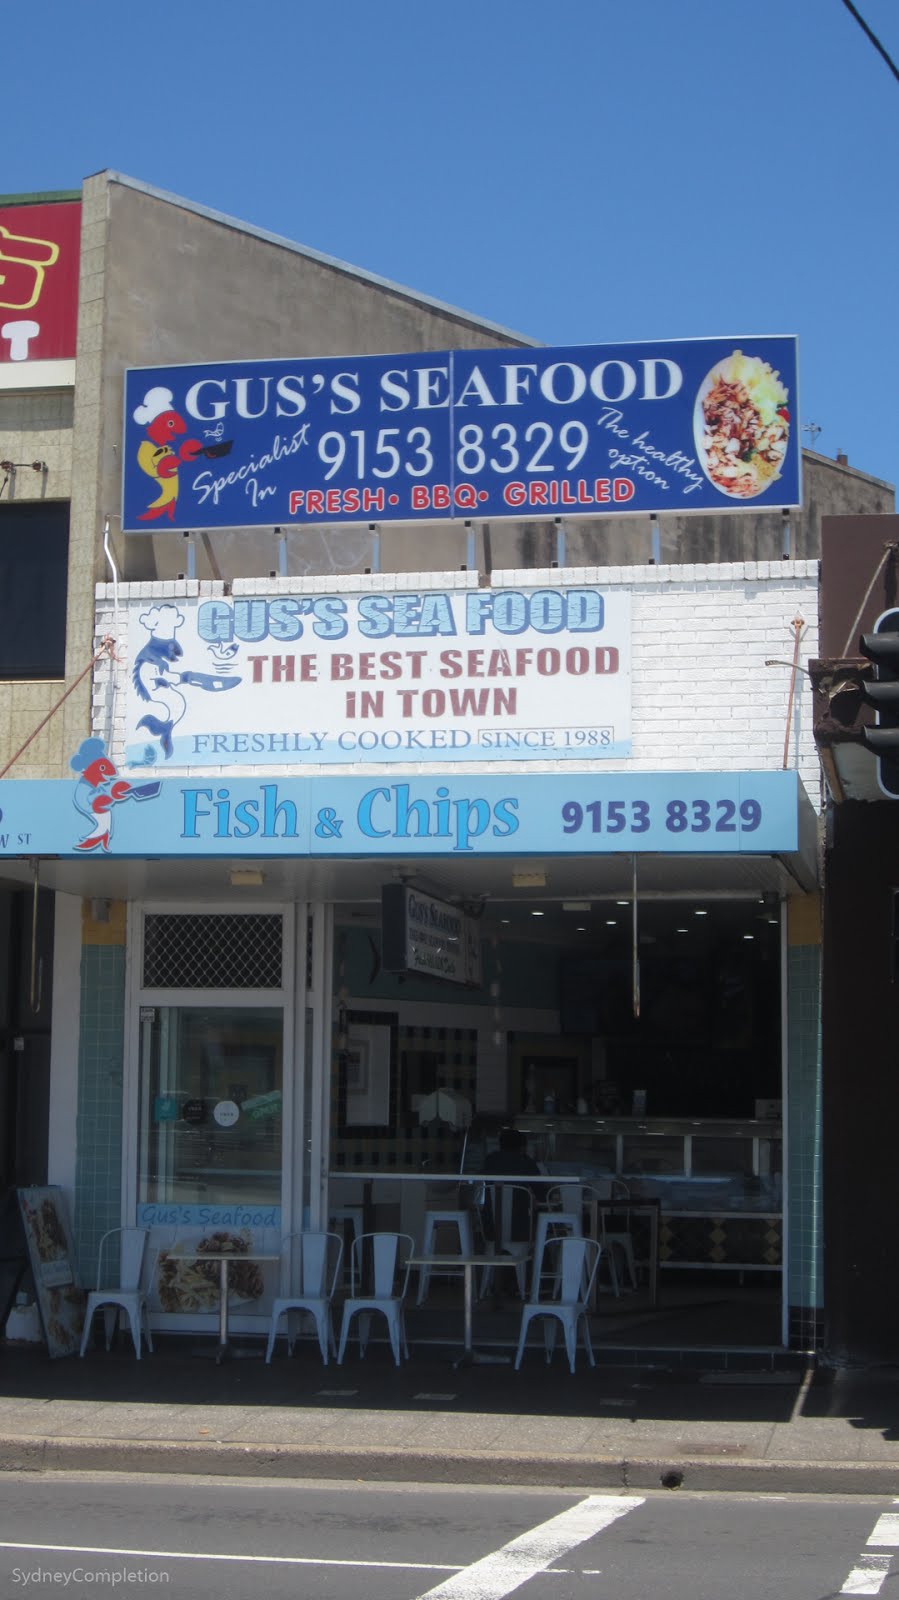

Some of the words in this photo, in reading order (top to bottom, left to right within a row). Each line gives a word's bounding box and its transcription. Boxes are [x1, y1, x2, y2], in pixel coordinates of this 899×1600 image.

[185, 372, 361, 421] GUS'S
[380, 358, 683, 412] SEAFOOD
[192, 423, 311, 505] Specialist
[318, 426, 433, 481] 9153
[456, 420, 588, 475] 8329
[597, 406, 630, 438] The
[631, 431, 704, 494] healthy
[608, 448, 670, 490] option
[245, 478, 277, 507] In
[503, 478, 635, 507] GRILLED
[198, 596, 348, 643] GUS'S
[358, 592, 457, 639] SEA
[466, 589, 605, 635] FOOD
[248, 653, 318, 683] THE
[330, 651, 428, 681] BEST
[439, 646, 619, 679] SEAFOOD
[396, 687, 517, 718] TOWN
[192, 731, 329, 754] FRESHLY
[338, 729, 471, 751] COOKED
[481, 731, 556, 749] SINCE
[564, 729, 611, 746] 1988
[180, 784, 299, 838] Fish
[314, 807, 344, 838] &
[357, 783, 520, 851] Chips
[562, 800, 650, 834] 9153
[665, 798, 762, 832] 8329
[17, 832, 32, 845] ST
[142, 1205, 192, 1225] Gus's
[199, 1206, 276, 1226] Seafood
